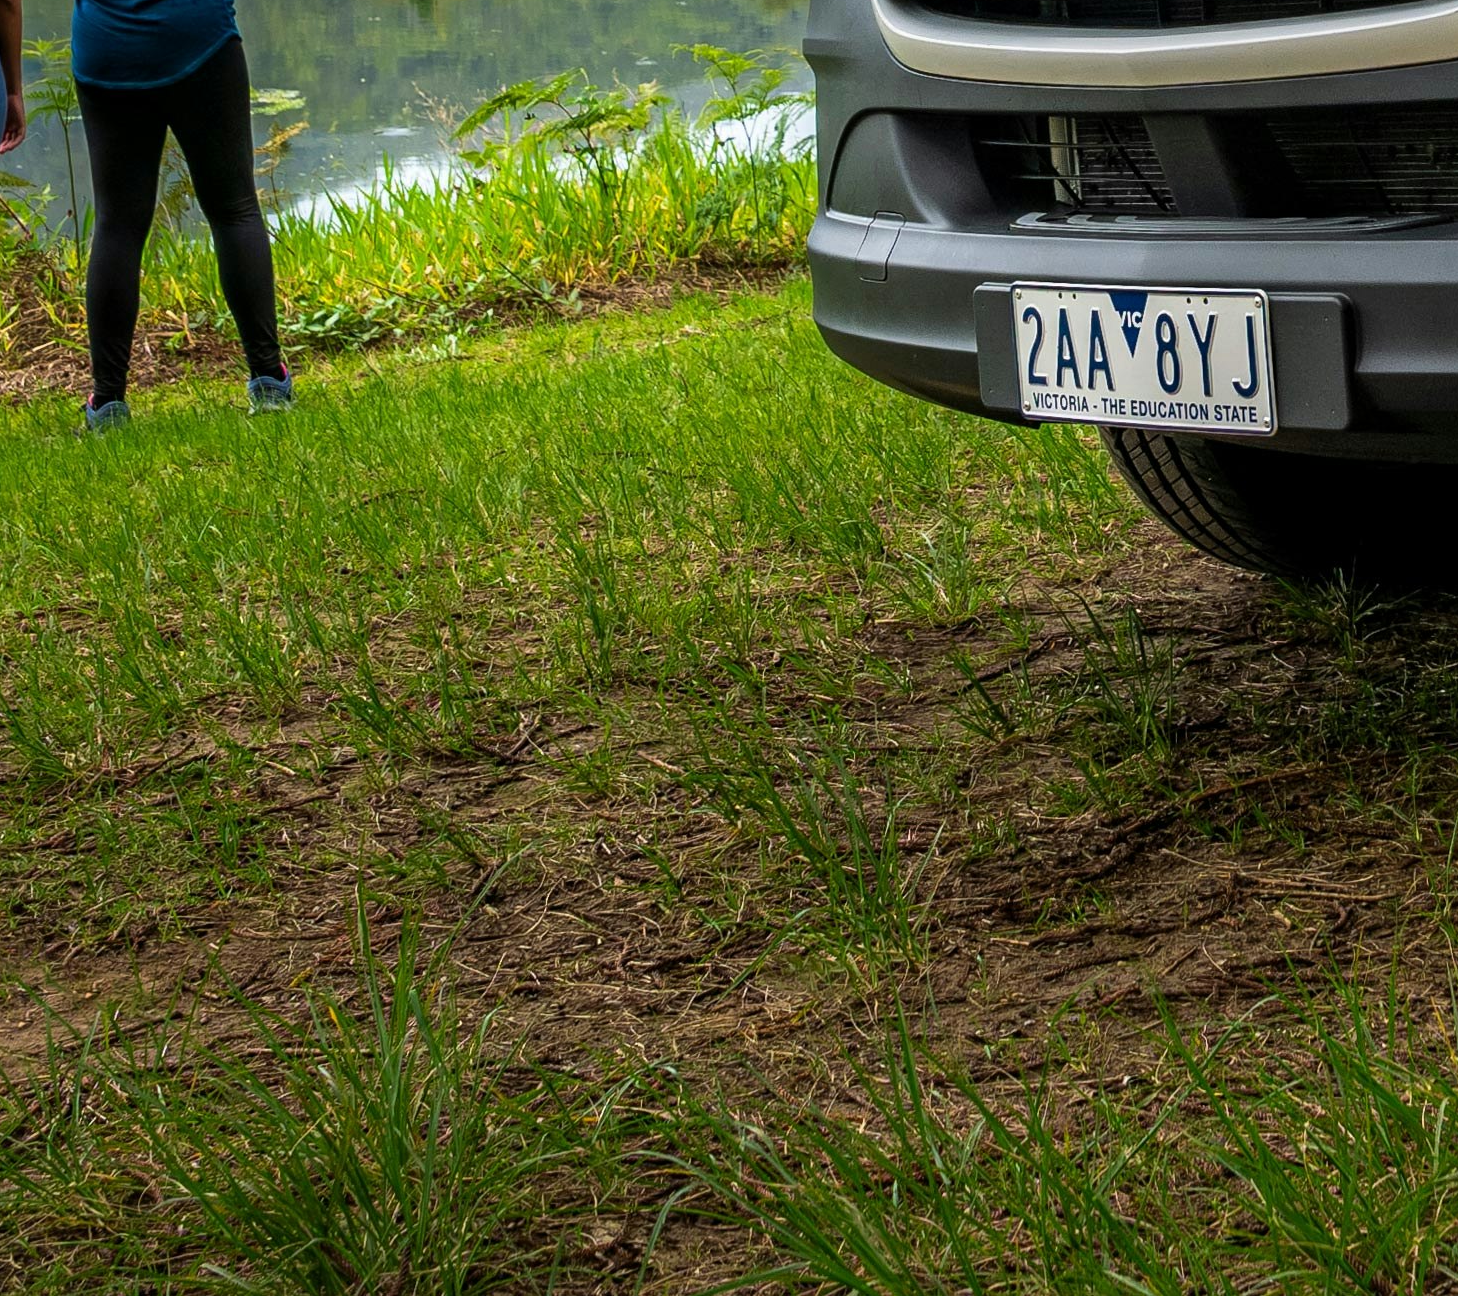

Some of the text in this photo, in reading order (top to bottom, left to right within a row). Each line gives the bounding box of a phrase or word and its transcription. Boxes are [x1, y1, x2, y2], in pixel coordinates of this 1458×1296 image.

[1033, 392, 1090, 413] VICTORIA
[1101, 397, 1127, 415] THE
[1131, 399, 1210, 421] EDUCATION
[1214, 404, 1258, 423] STATE
